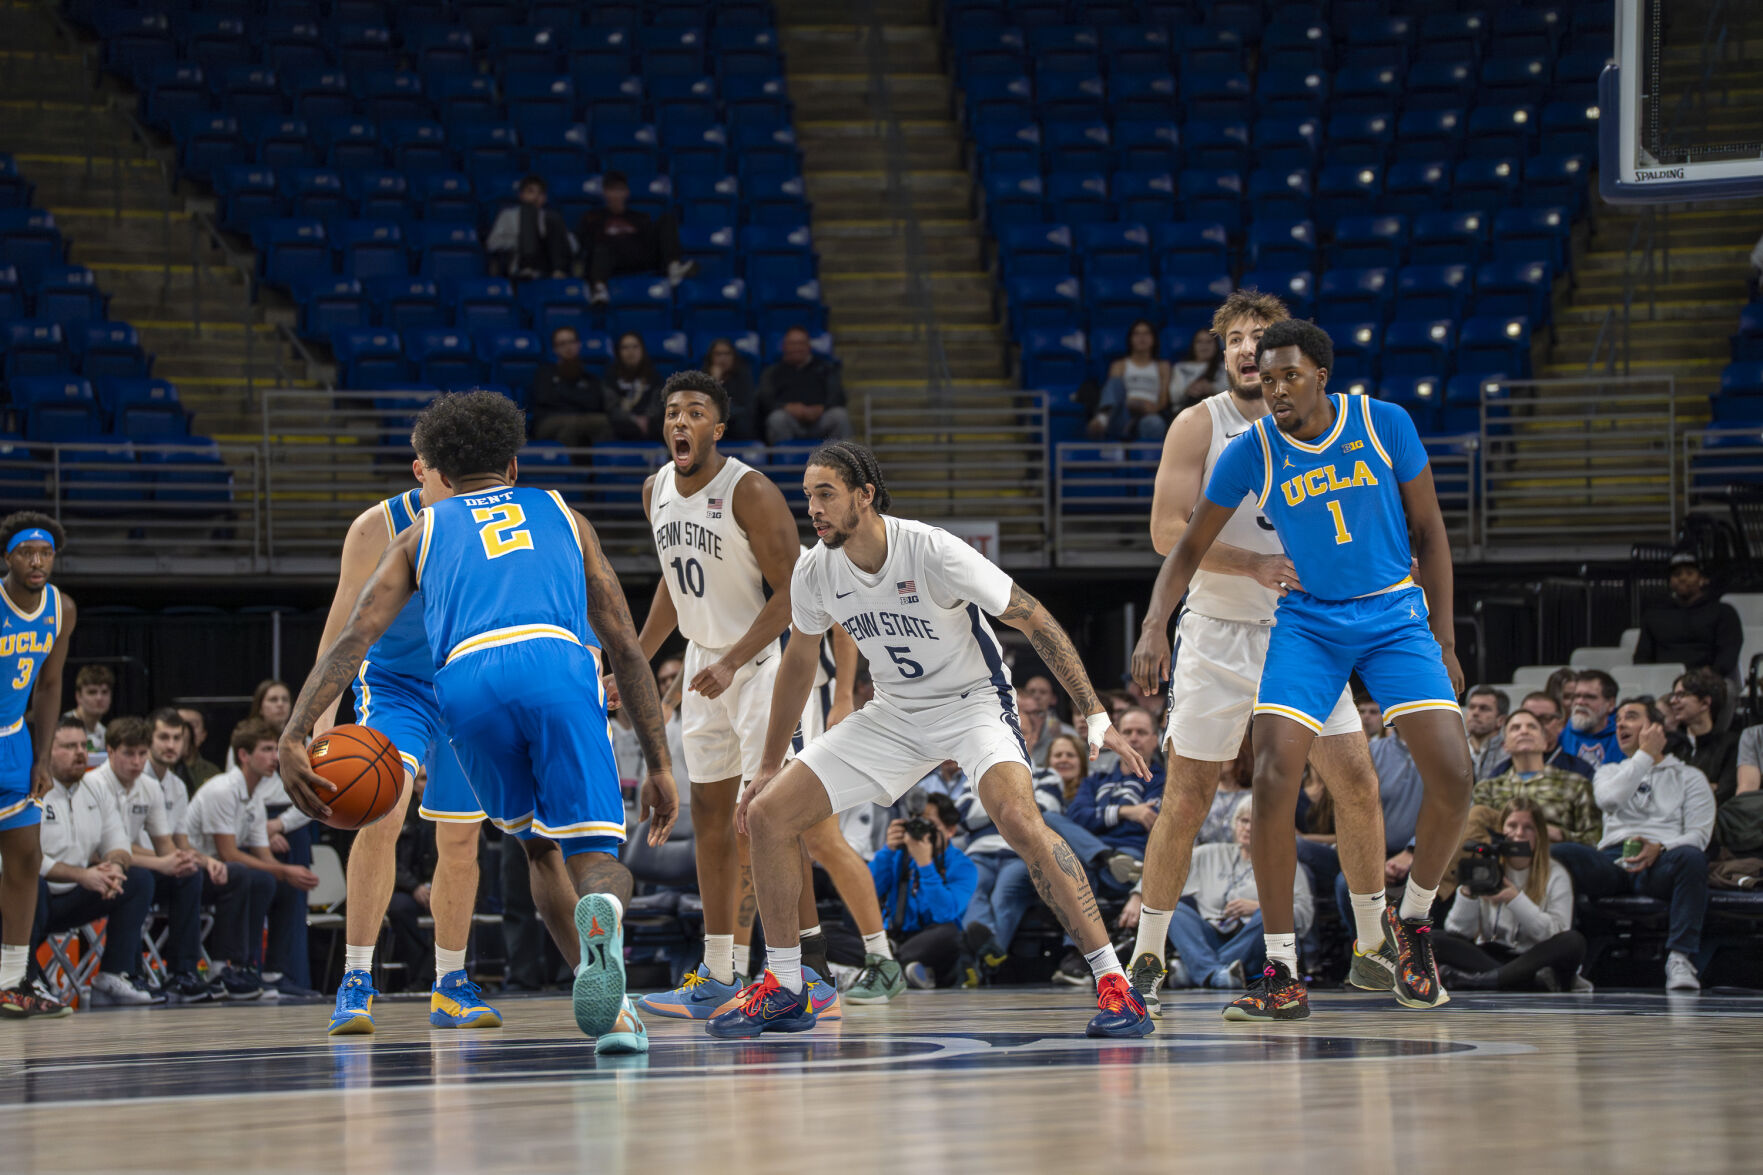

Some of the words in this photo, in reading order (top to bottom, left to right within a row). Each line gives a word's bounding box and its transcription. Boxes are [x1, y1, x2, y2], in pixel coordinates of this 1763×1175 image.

[1635, 168, 1684, 182] SPALDING
[464, 491, 514, 507] DENT
[1281, 461, 1378, 507] UCLA
[471, 503, 535, 560] 2
[1326, 500, 1353, 545] 1
[656, 521, 681, 555] PENN
[685, 521, 723, 561] STATE
[670, 557, 704, 598] 10
[842, 612, 881, 641] PENN
[879, 612, 940, 641] STATE
[0, 631, 53, 657] UCLA
[12, 657, 34, 690] 3
[884, 645, 924, 679] 5
